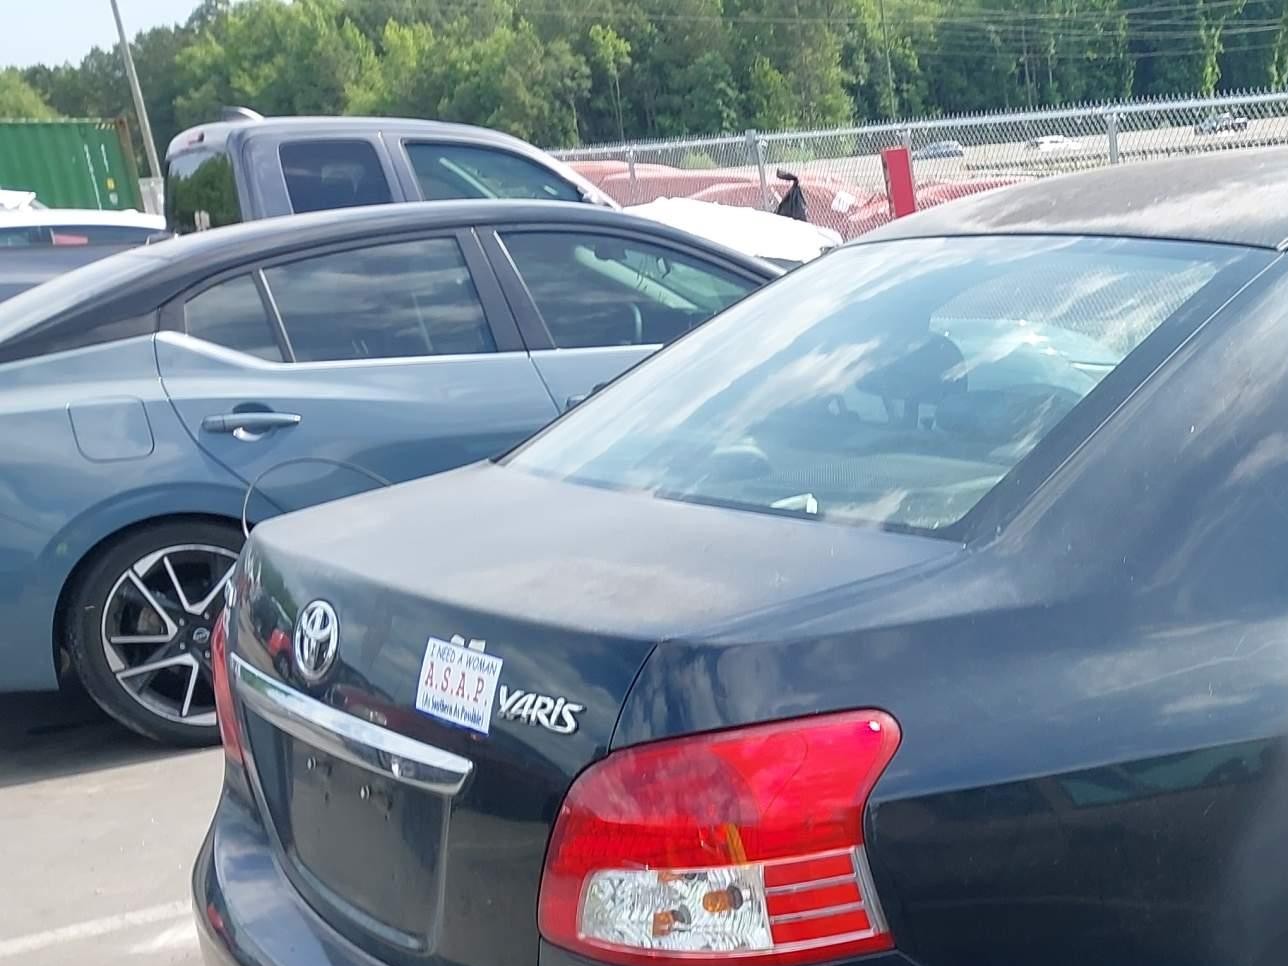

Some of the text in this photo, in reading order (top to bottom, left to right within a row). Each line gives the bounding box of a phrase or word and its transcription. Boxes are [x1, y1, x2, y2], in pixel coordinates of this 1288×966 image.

[424, 660, 488, 707] A.S.A.P.
[437, 646, 456, 663] NEED
[458, 653, 464, 664] A
[465, 655, 497, 676] WOMAN
[499, 684, 584, 734] VARIS
